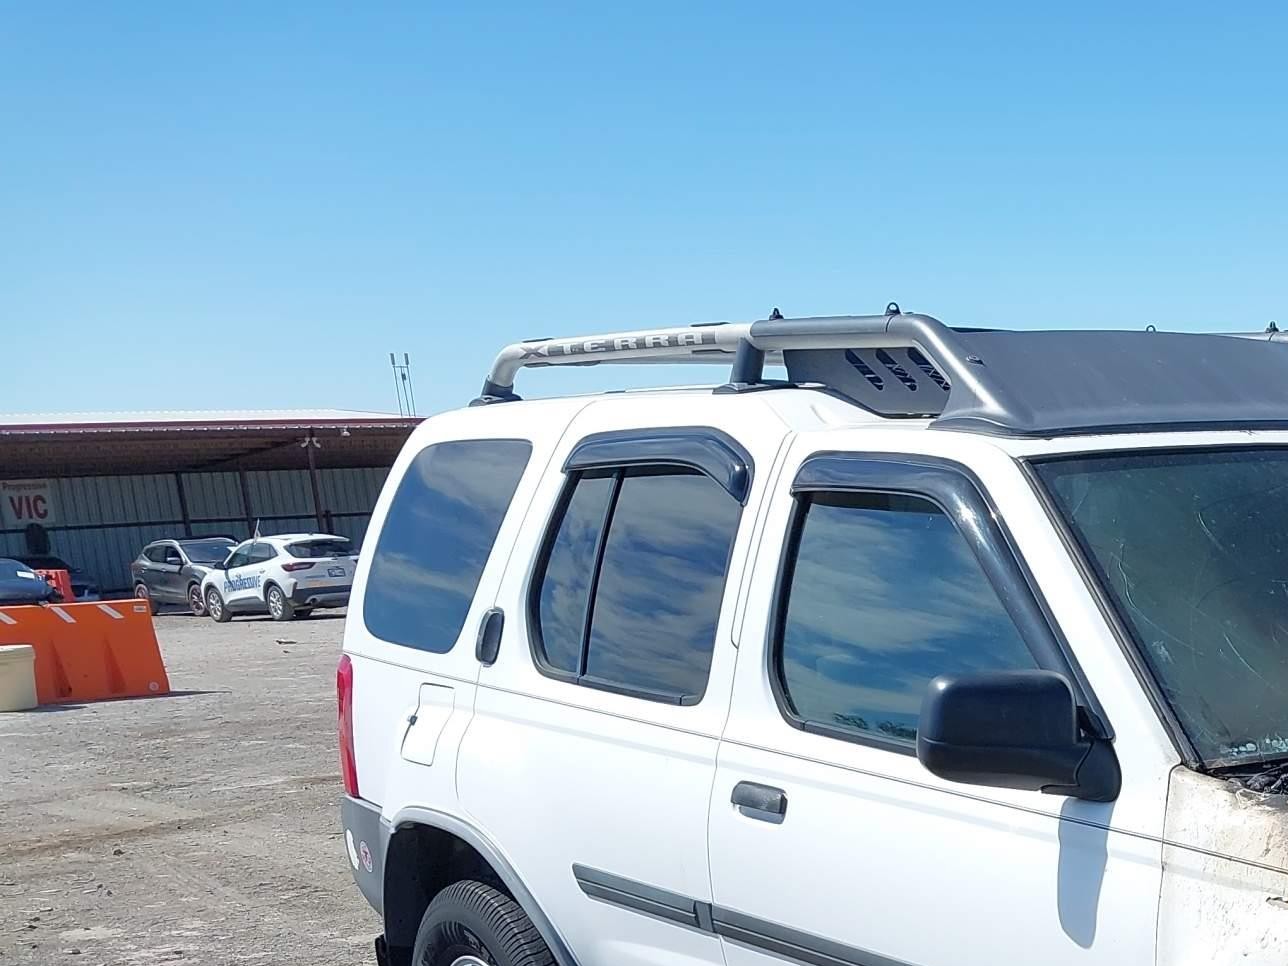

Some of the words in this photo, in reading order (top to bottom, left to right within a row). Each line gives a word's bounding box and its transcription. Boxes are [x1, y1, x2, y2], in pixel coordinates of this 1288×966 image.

[519, 331, 704, 360] XTERRA
[9, 495, 48, 520] VIC
[223, 575, 261, 592] PROGRESSIVE
